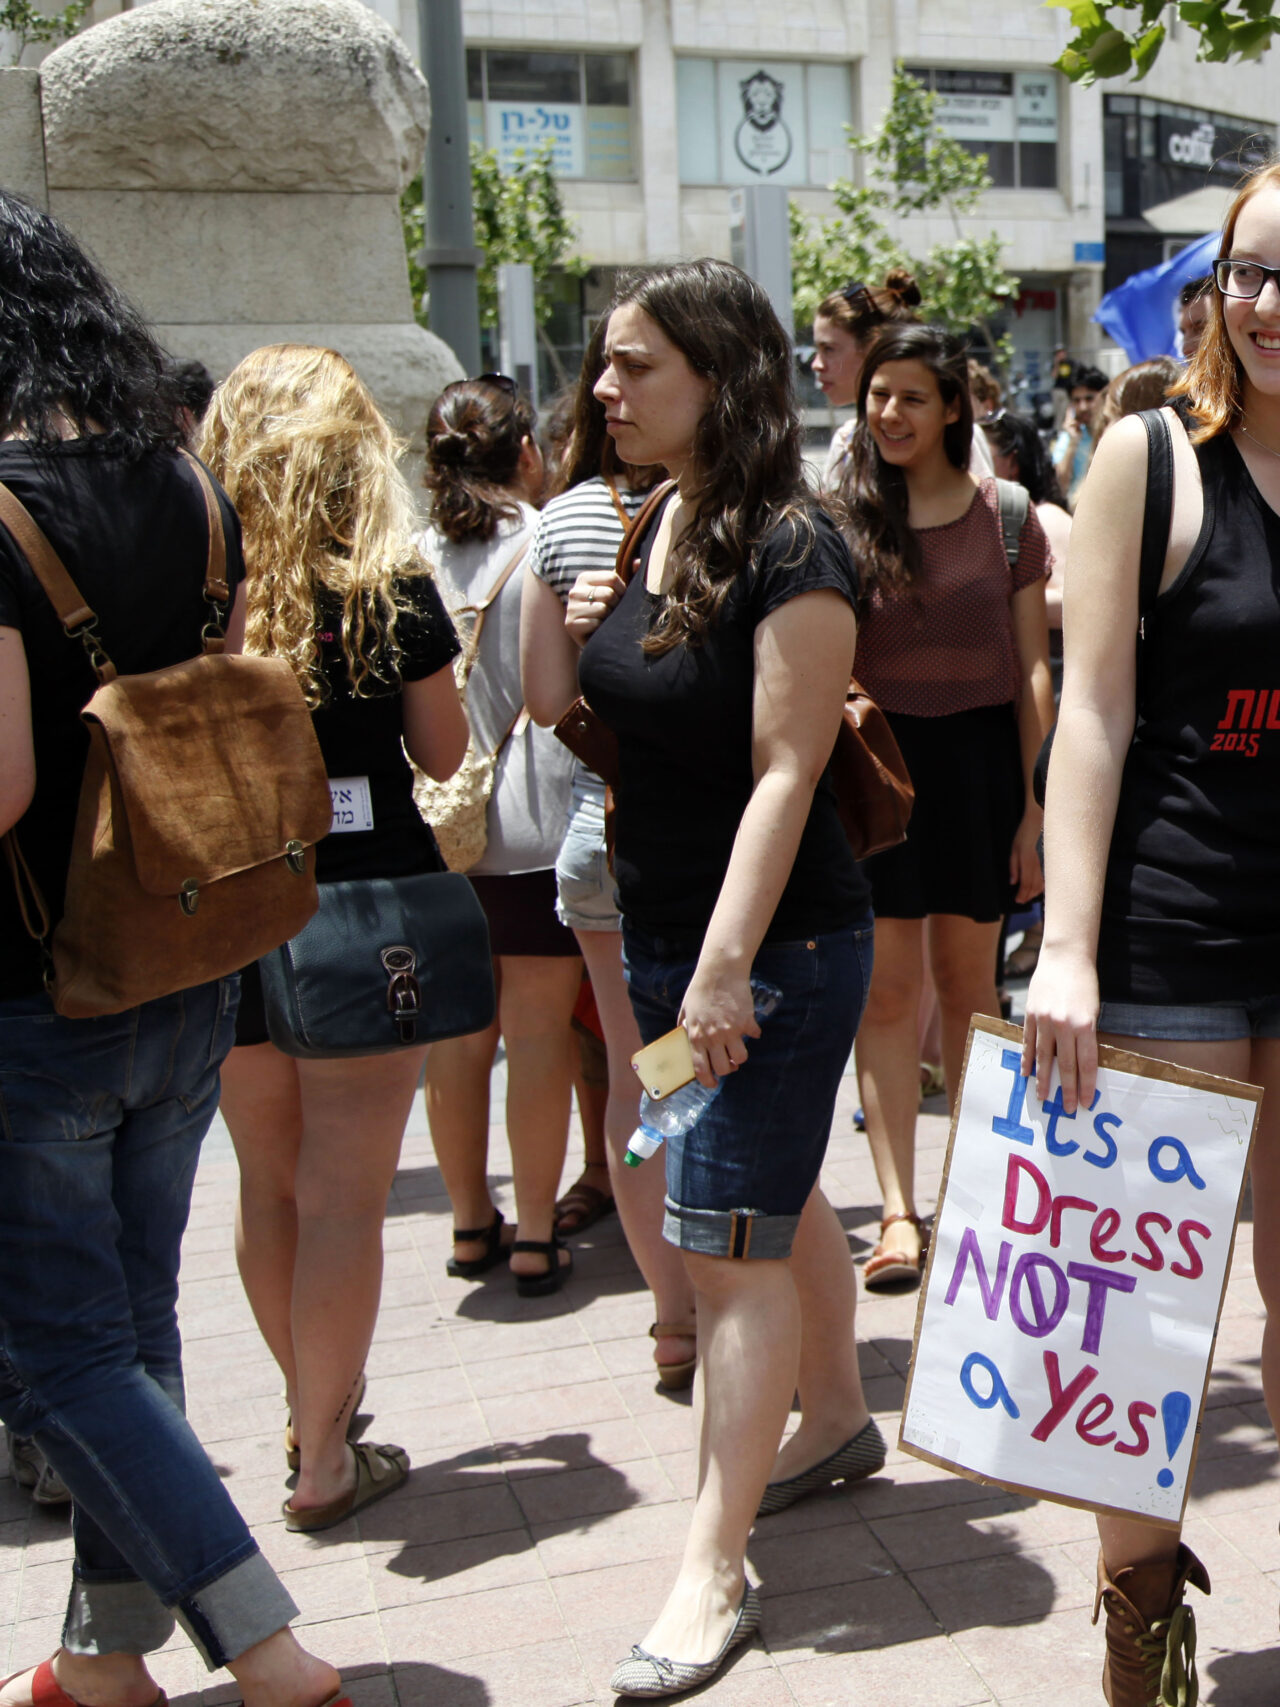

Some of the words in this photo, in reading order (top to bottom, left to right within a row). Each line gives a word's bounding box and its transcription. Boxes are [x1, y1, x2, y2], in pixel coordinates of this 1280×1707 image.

[501, 107, 570, 132] טל-רן
[1209, 733, 1261, 757] 2015
[991, 1048, 1123, 1169] It's
[1147, 1135, 1206, 1191] a
[1001, 1153, 1212, 1280] Dress
[944, 1226, 1138, 1356] NOT
[959, 1351, 1021, 1420] a
[1030, 1350, 1192, 1488] Yes!
